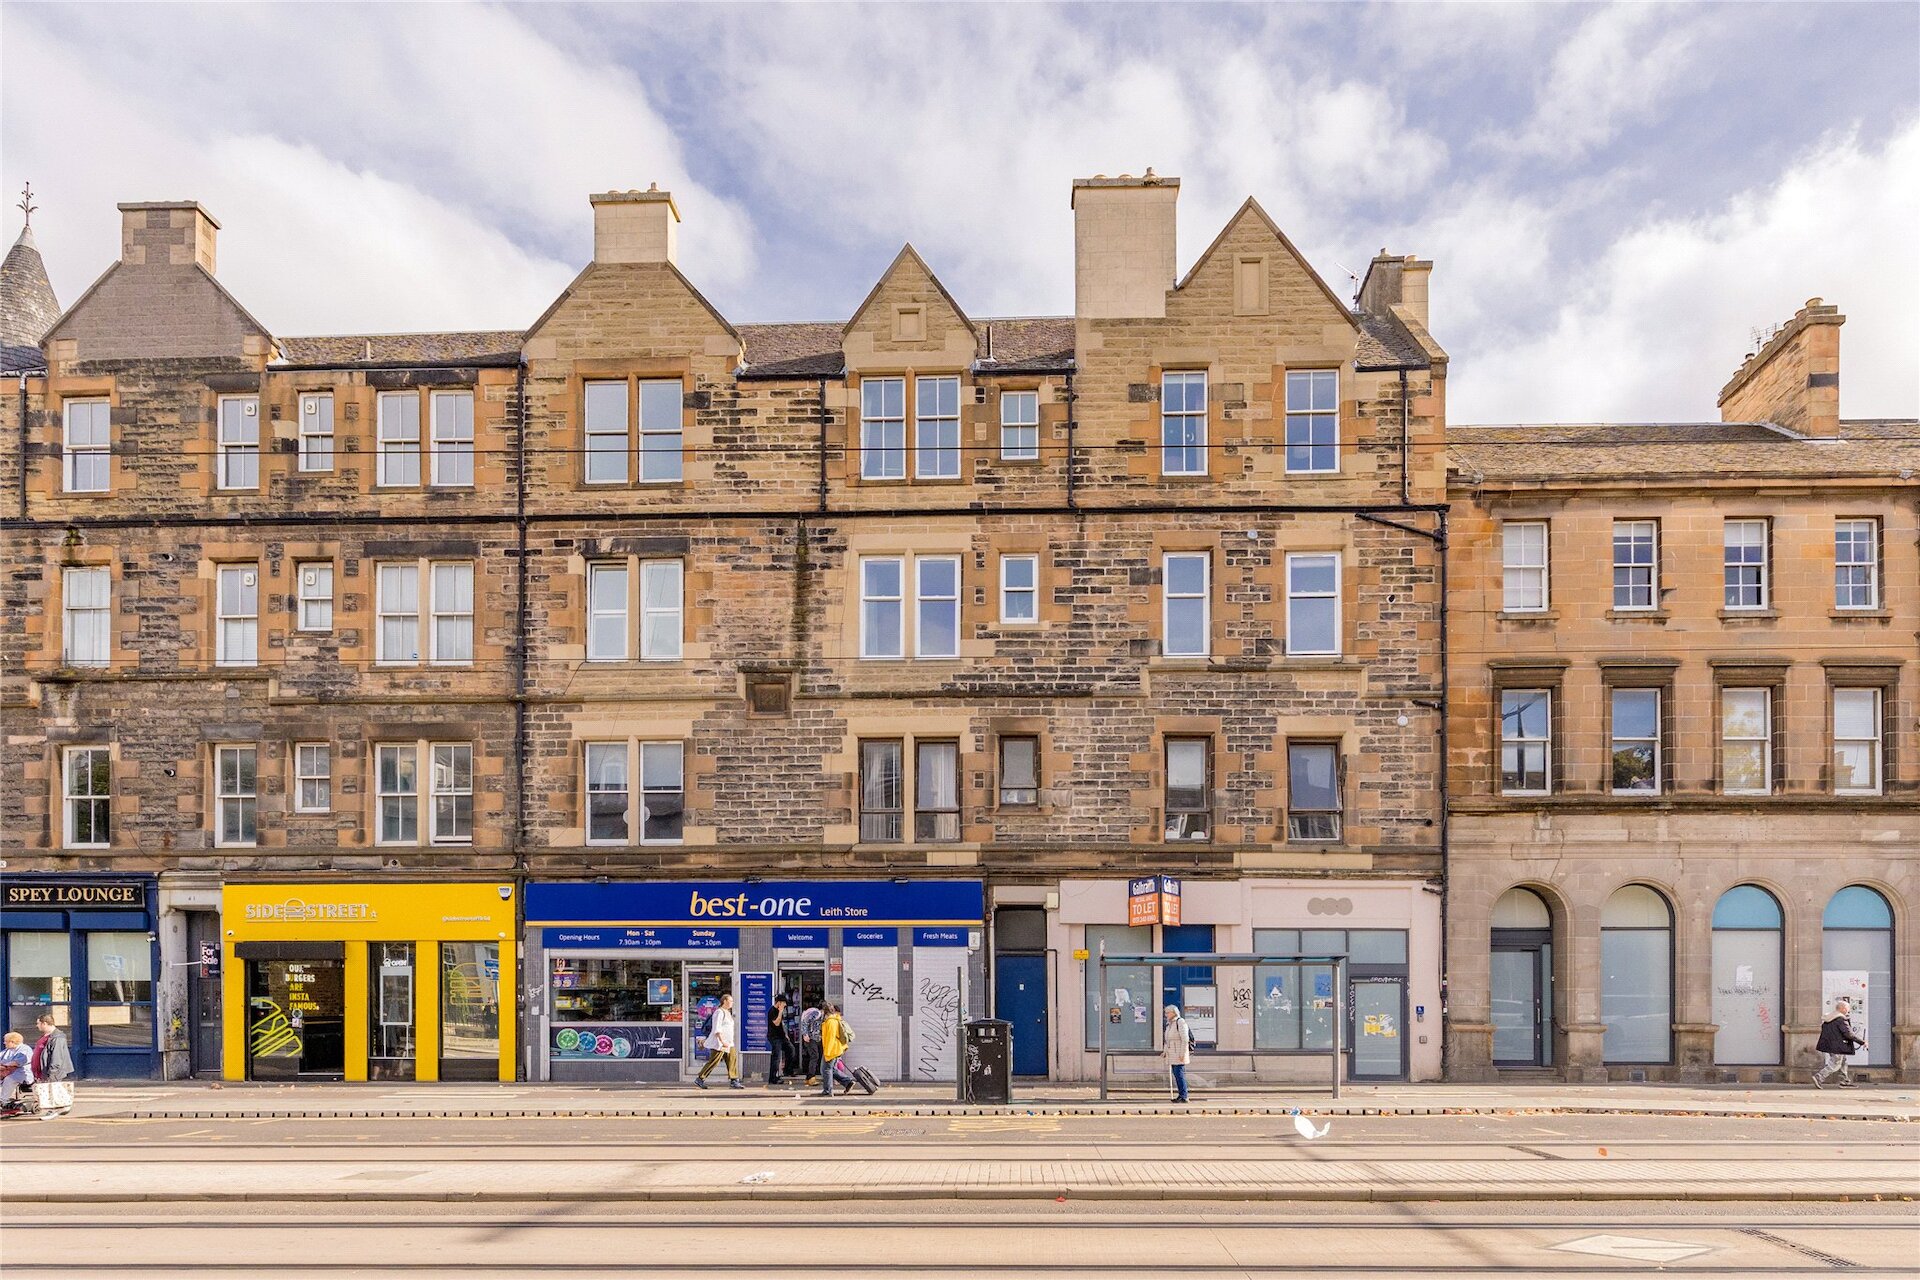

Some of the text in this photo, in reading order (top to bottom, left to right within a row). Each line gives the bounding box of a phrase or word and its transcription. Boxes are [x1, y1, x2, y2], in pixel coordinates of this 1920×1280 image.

[9, 886, 135, 902] SPEY LOUNGE
[690, 891, 868, 917] best-one Leith Store
[1132, 901, 1156, 915] TO LET
[305, 903, 369, 919] STREET
[558, 934, 582, 942] Opening
[692, 930, 716, 938] Sunday
[856, 932, 884, 940] Groceries
[922, 932, 958, 940] Fresh Meats
[645, 939, 662, 947] 10pm
[705, 939, 722, 947] 10pm
[201, 946, 214, 956] For
[202, 955, 219, 965] Sale
[285, 973, 316, 983] BURGERS
[289, 983, 304, 991] ARE
[289, 992, 310, 1001] INSTA
